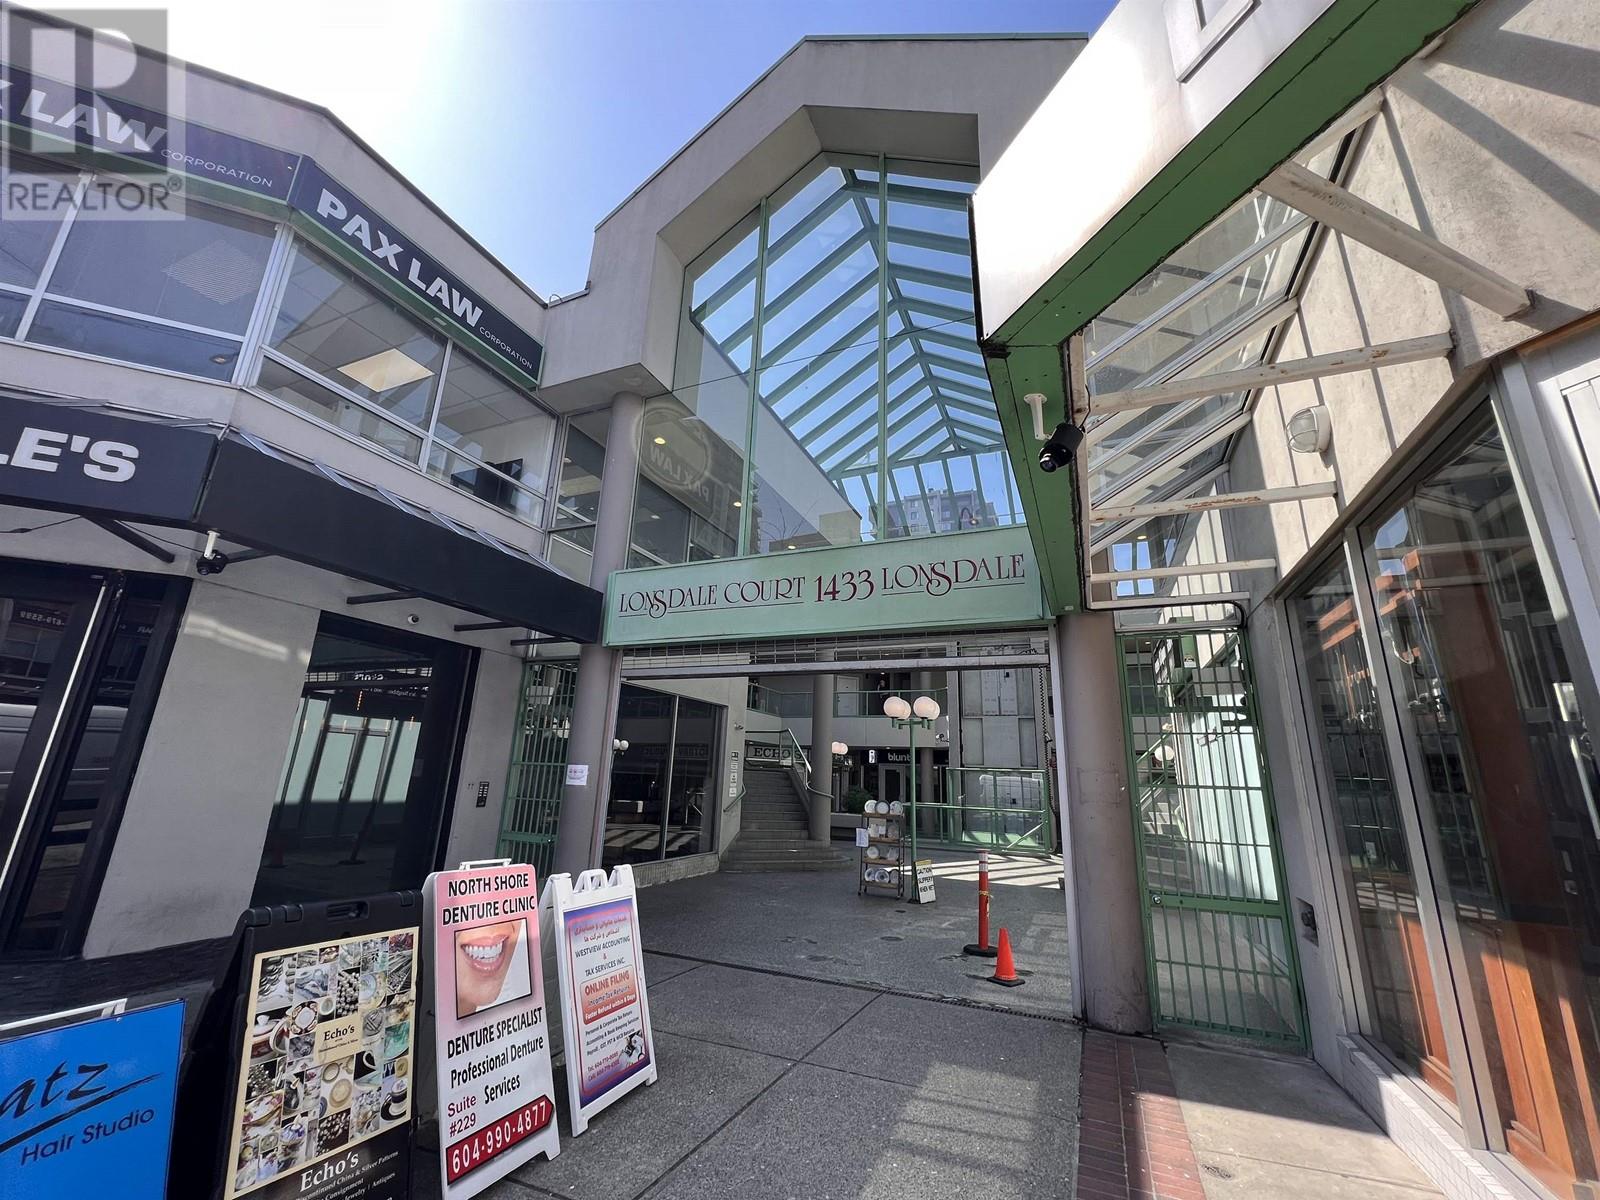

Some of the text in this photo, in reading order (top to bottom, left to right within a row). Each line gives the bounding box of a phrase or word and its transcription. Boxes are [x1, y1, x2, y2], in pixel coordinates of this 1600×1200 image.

[20, 88, 168, 152] LAW
[160, 149, 273, 188] CORPORATION
[316, 188, 533, 370] PAX LAW CORPORATION
[619, 553, 1025, 619] LONSDALE COURT 1433 LONSDALE
[753, 747, 802, 760] ECHOS
[448, 873, 529, 897] NORTH SHORE
[442, 896, 535, 926] DENTURE CLINIC
[575, 936, 630, 958] WESTVIEW ACCOUNTING
[584, 970, 630, 996] ONLINE FILING
[585, 968, 594, 977] TAX
[595, 959, 619, 975] SERVICES
[323, 1024, 355, 1041] Echo's
[447, 1007, 542, 1059] DENTURE SPECIALIST
[451, 1036, 544, 1089] Professional Denture
[484, 1073, 521, 1105] Services
[447, 1095, 477, 1118] Suite
[20, 1109, 155, 1166] Hair Studio
[449, 1112, 477, 1137] #229
[300, 1151, 359, 1192] Echo's
